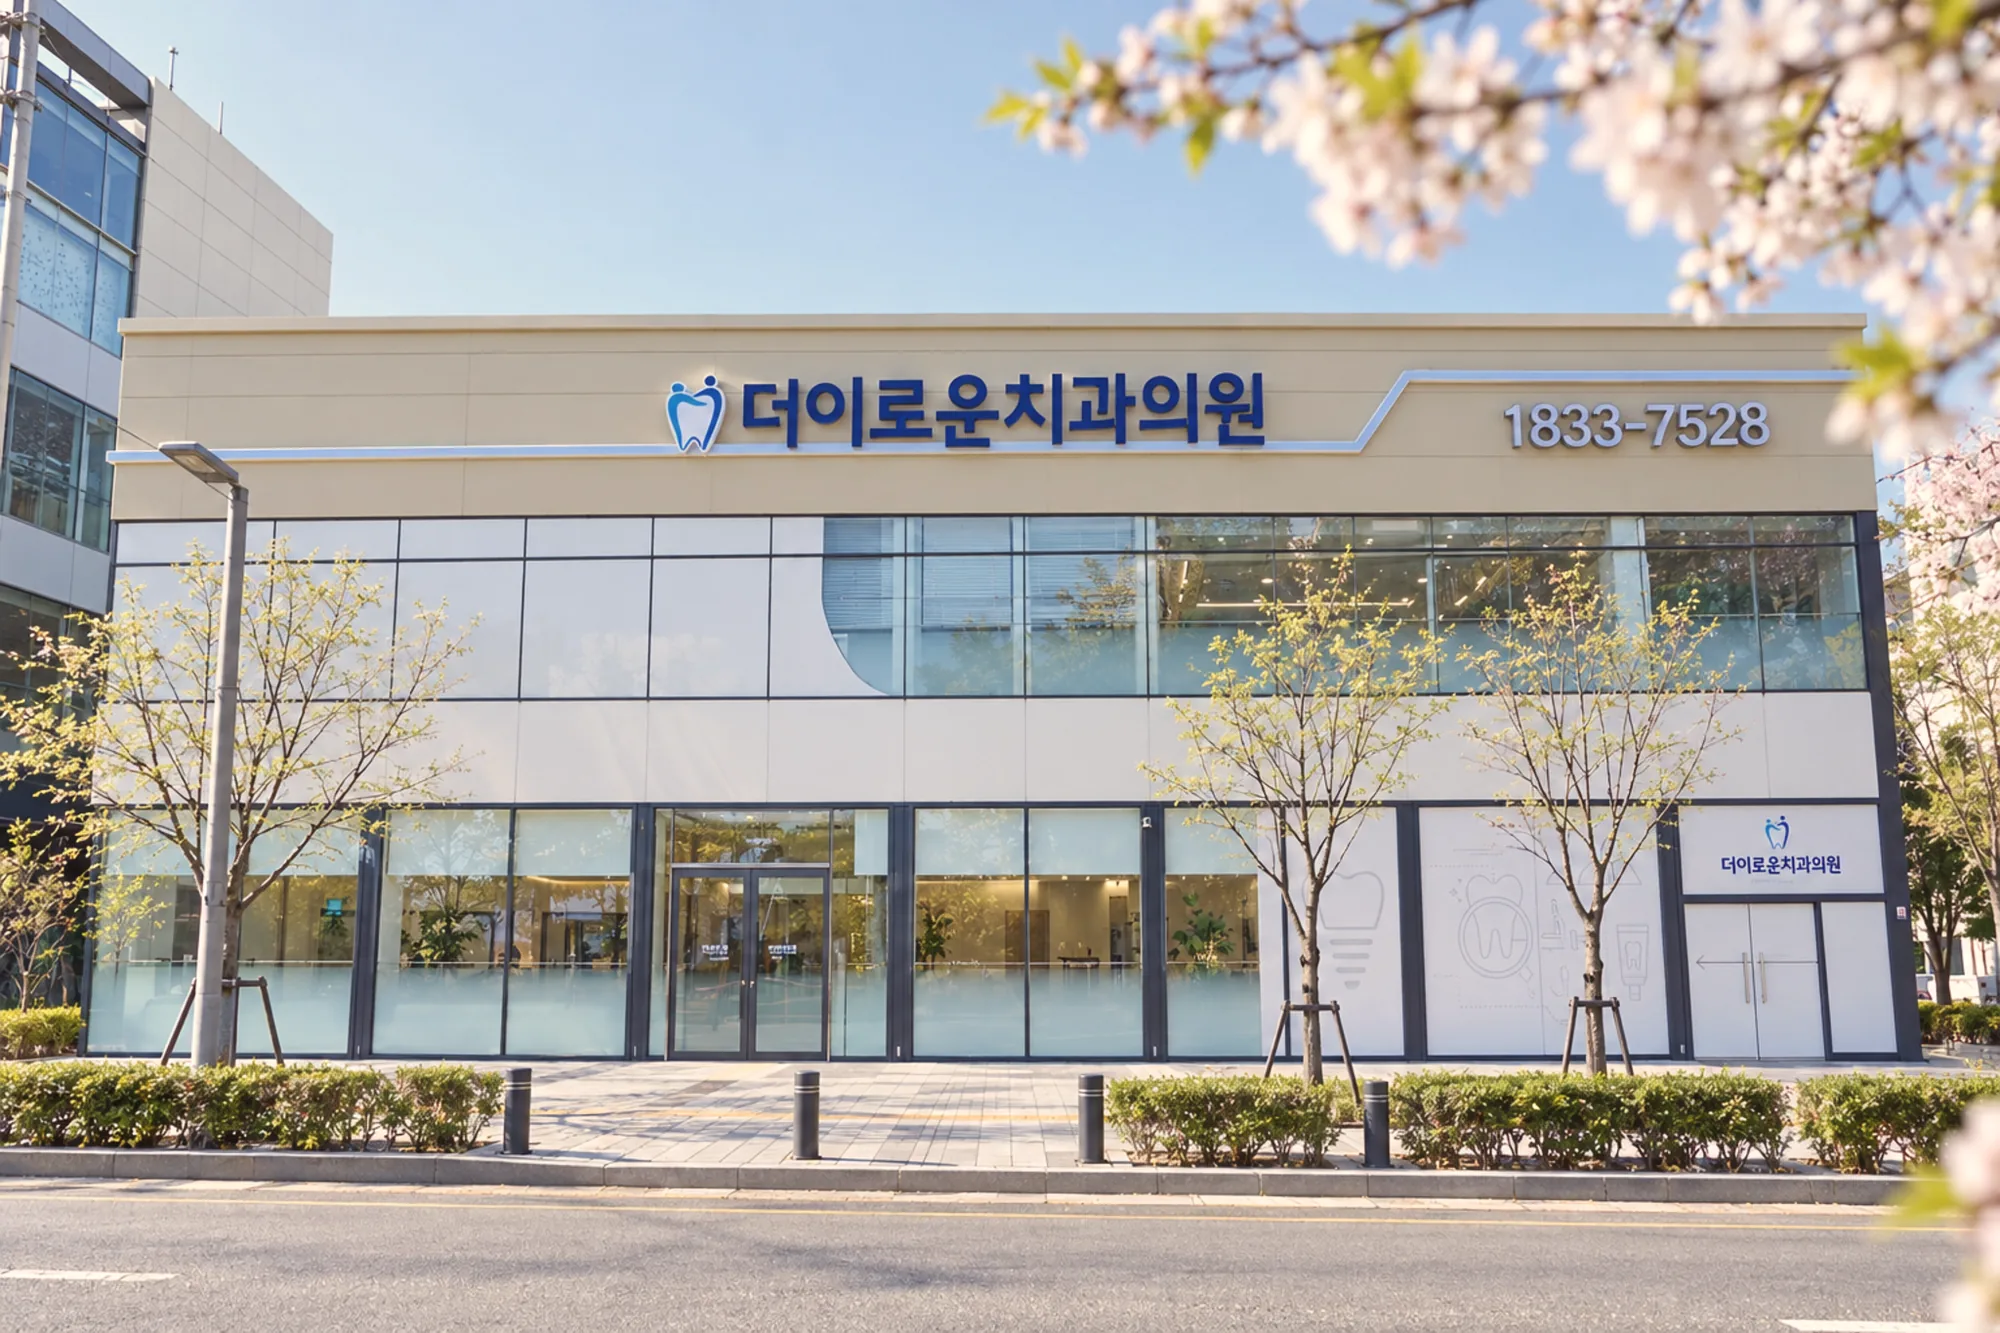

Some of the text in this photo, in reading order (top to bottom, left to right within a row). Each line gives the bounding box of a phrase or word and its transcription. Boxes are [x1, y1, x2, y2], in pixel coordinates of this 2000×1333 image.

[742, 372, 1265, 448] 더이로운치과의원
[1504, 402, 1771, 448] 1833-7528
[1721, 856, 1841, 874] 더이로운치과의원
